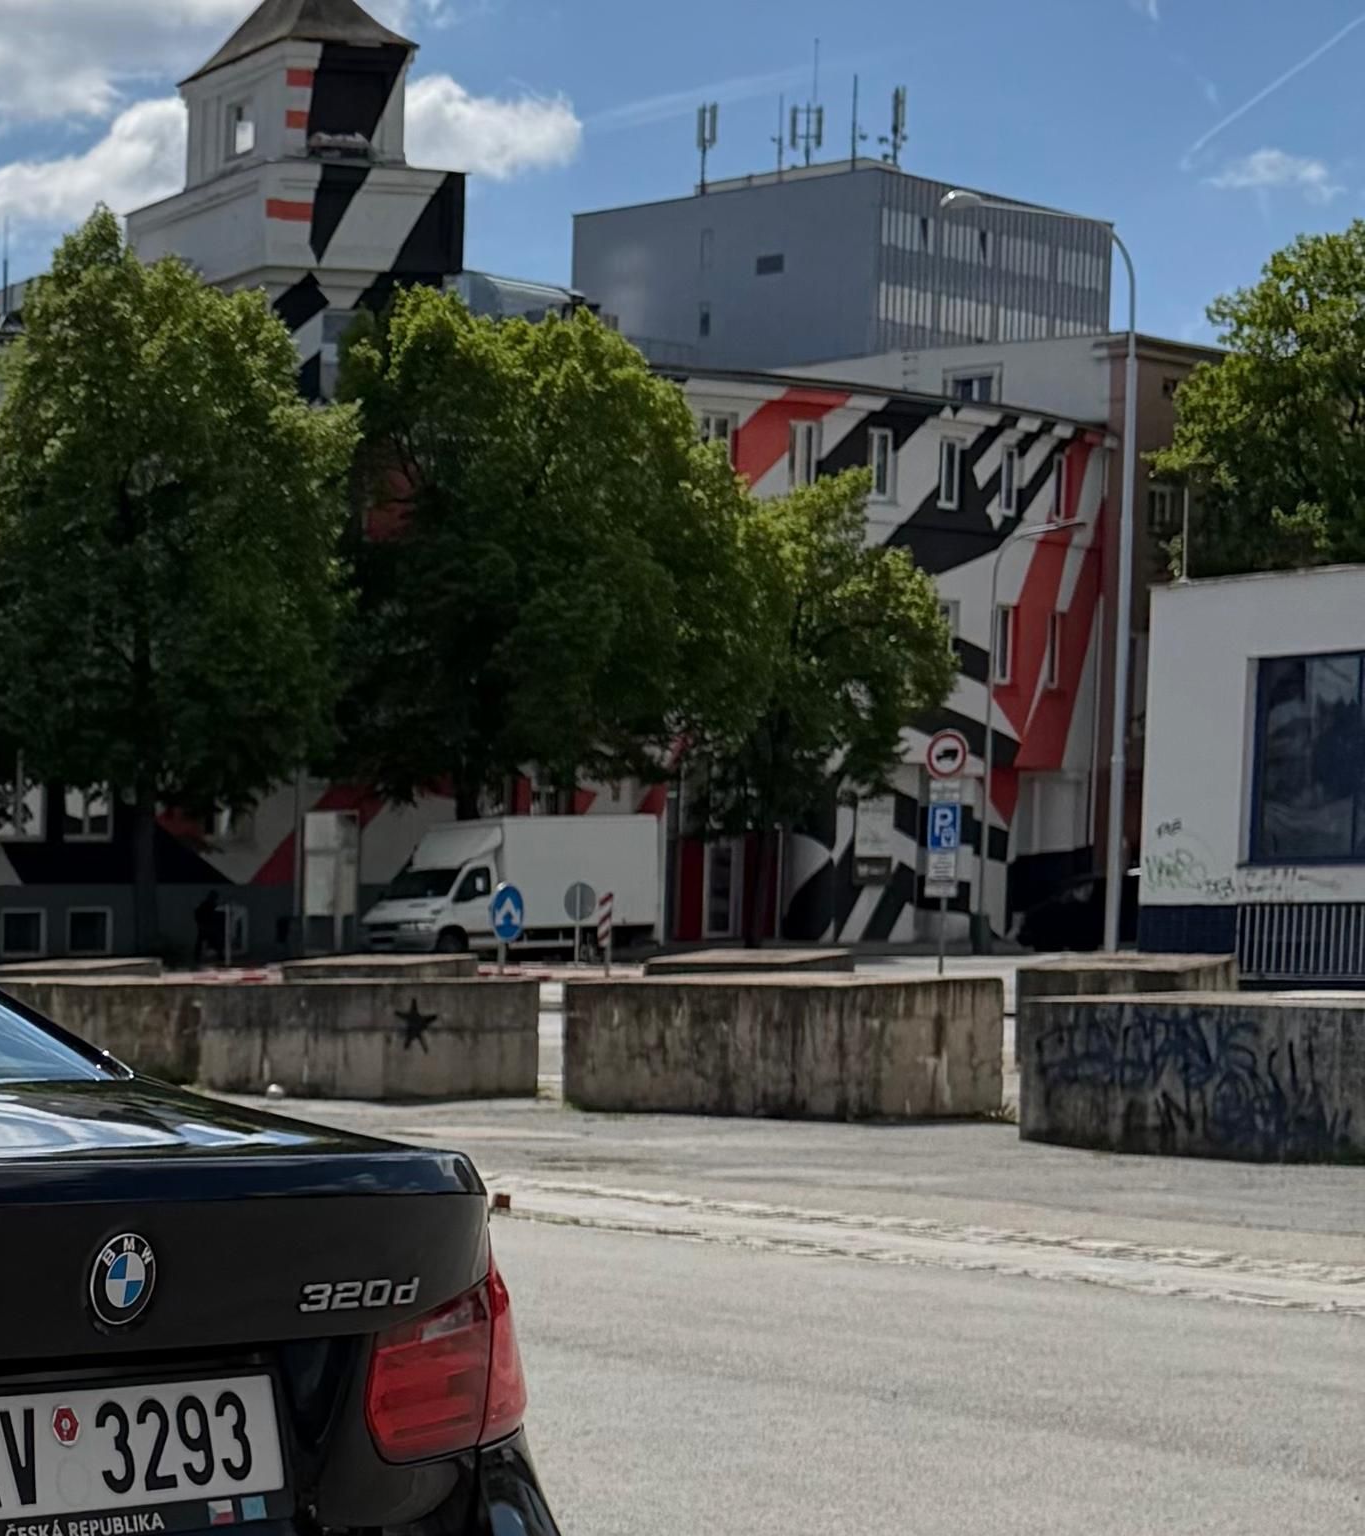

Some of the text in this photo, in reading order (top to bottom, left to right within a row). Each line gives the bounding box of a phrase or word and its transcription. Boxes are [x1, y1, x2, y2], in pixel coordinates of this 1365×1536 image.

[934, 808, 954, 837] P
[102, 1237, 154, 1267] BMW
[300, 1277, 420, 1312] 320d
[95, 1391, 252, 1494] 3293
